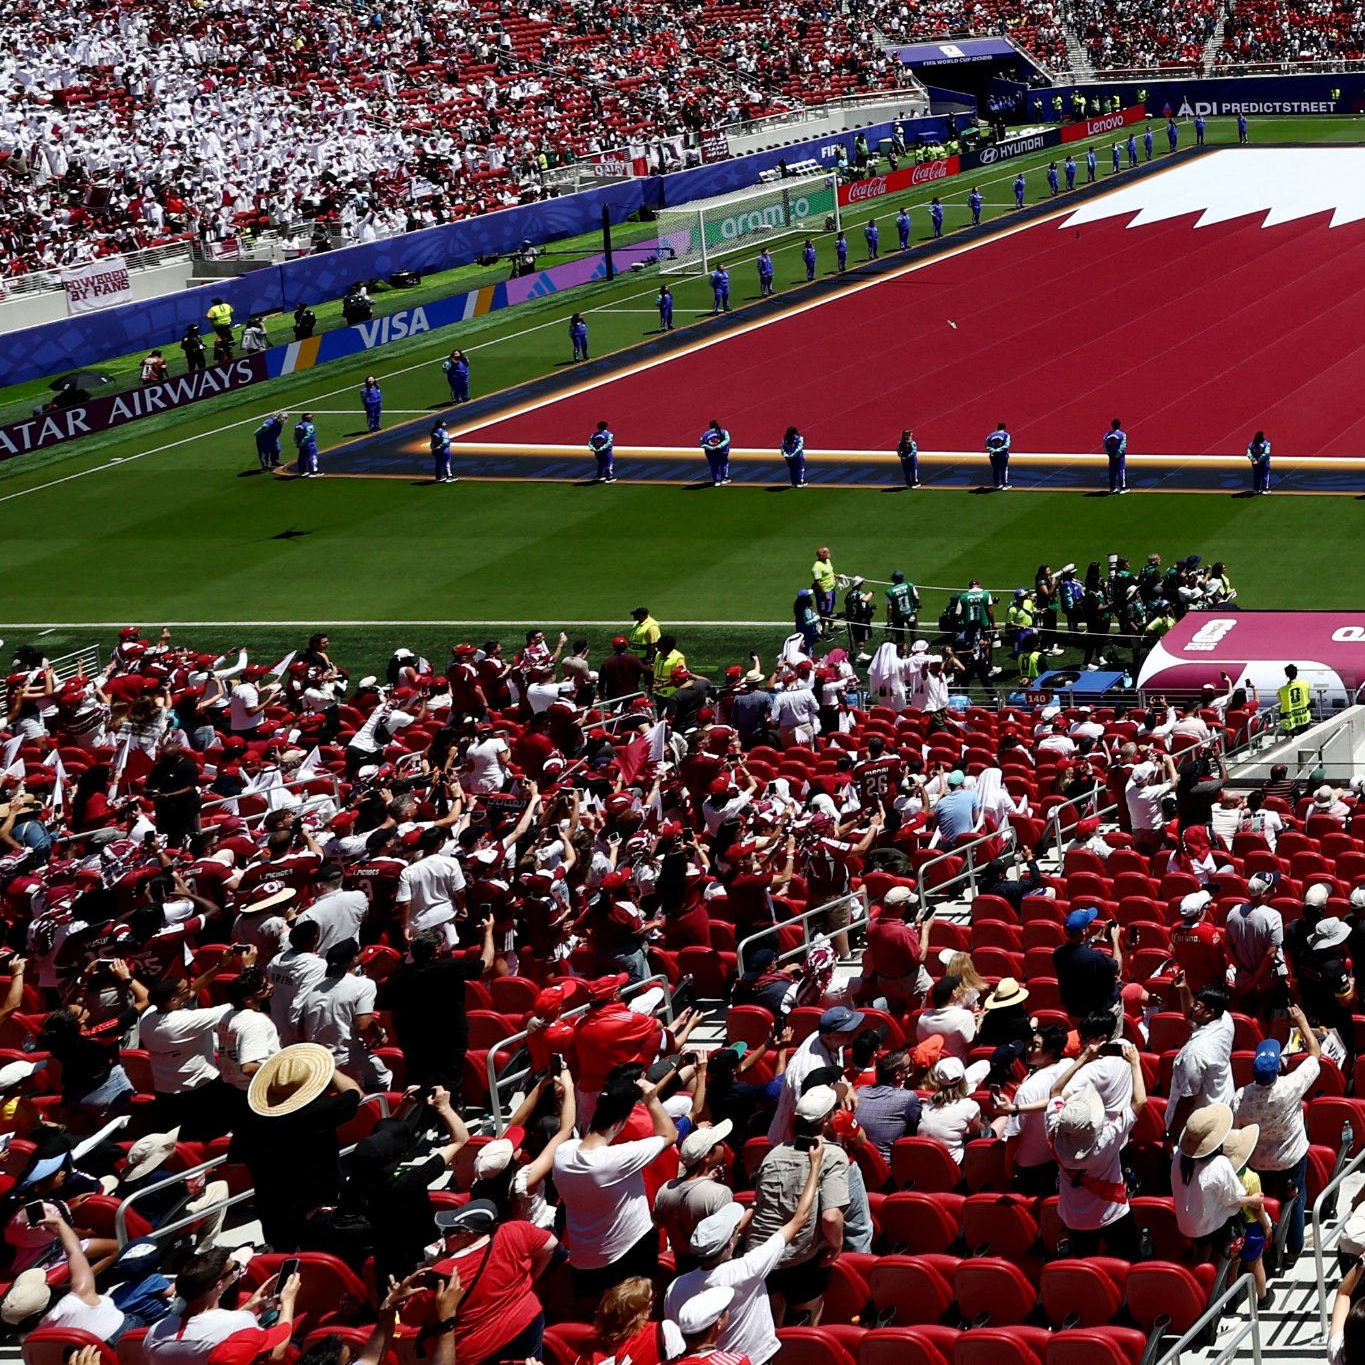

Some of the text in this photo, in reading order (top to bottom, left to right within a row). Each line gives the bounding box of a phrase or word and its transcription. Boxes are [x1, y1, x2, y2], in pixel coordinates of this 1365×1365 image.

[1177, 101, 1336, 116] ADI PREDICTSTREET
[1087, 115, 1124, 136] Lenovo
[1000, 136, 1044, 158] HYUNDAI
[912, 160, 948, 185] Coca-Cola
[848, 175, 888, 203] Coca-Cola
[65, 268, 128, 293] POWERED
[71, 279, 130, 302] BY FANS
[351, 306, 430, 349] VISA
[108, 359, 254, 426] AIRWAYS
[1028, 695, 1046, 703] 140
[865, 774, 888, 797] 26
[1171, 933, 1201, 943] Corona.
